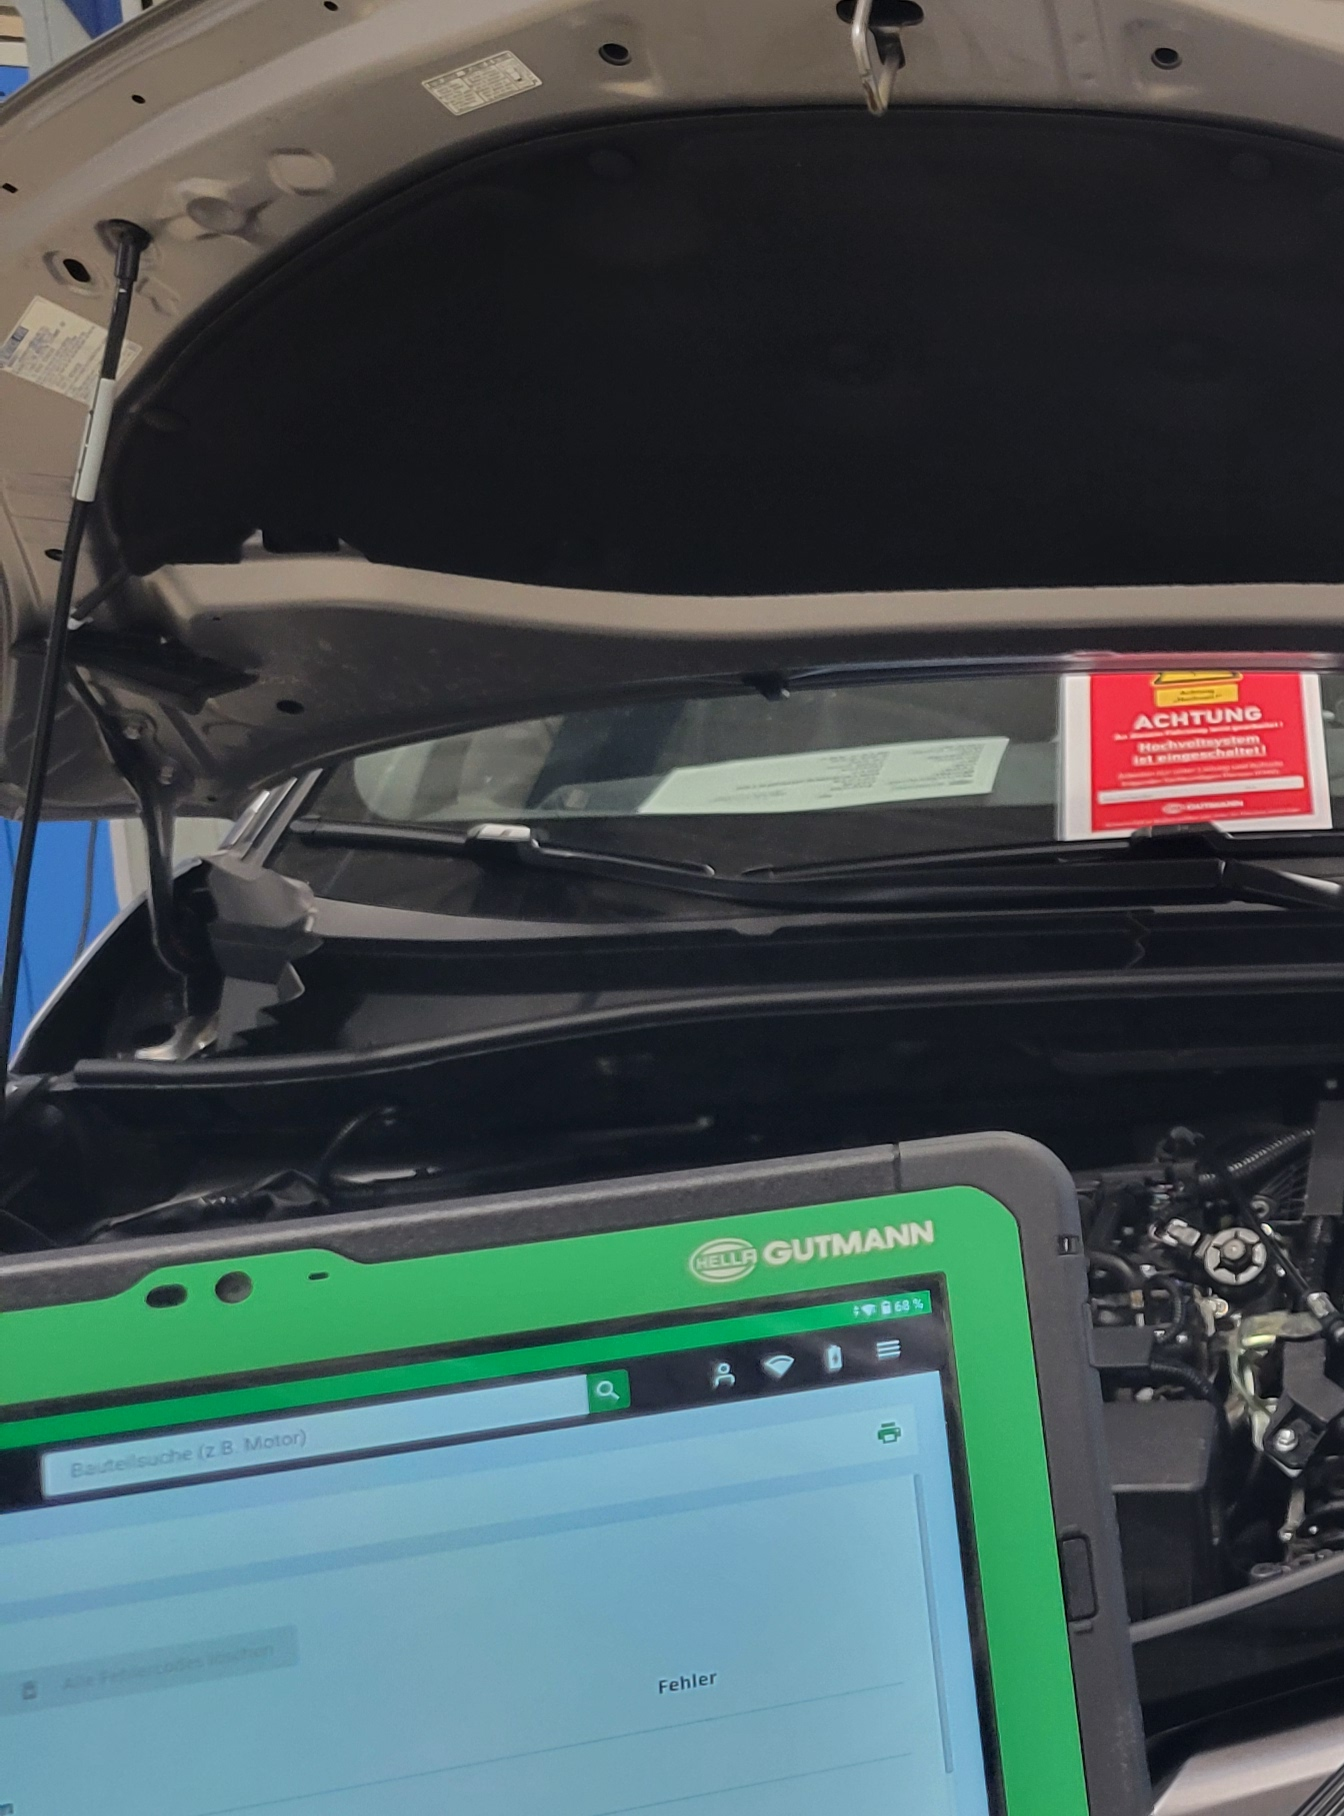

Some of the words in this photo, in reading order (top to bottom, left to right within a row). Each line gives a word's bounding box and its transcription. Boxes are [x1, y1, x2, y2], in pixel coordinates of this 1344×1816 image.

[1134, 706, 1262, 730] ACHTUNG
[1133, 754, 1152, 766] ist
[763, 1220, 935, 1265] GUTMANN
[71, 1448, 193, 1478] Bauteilsuche
[245, 1429, 307, 1452] Motor)
[659, 1673, 717, 1694] Fehler
